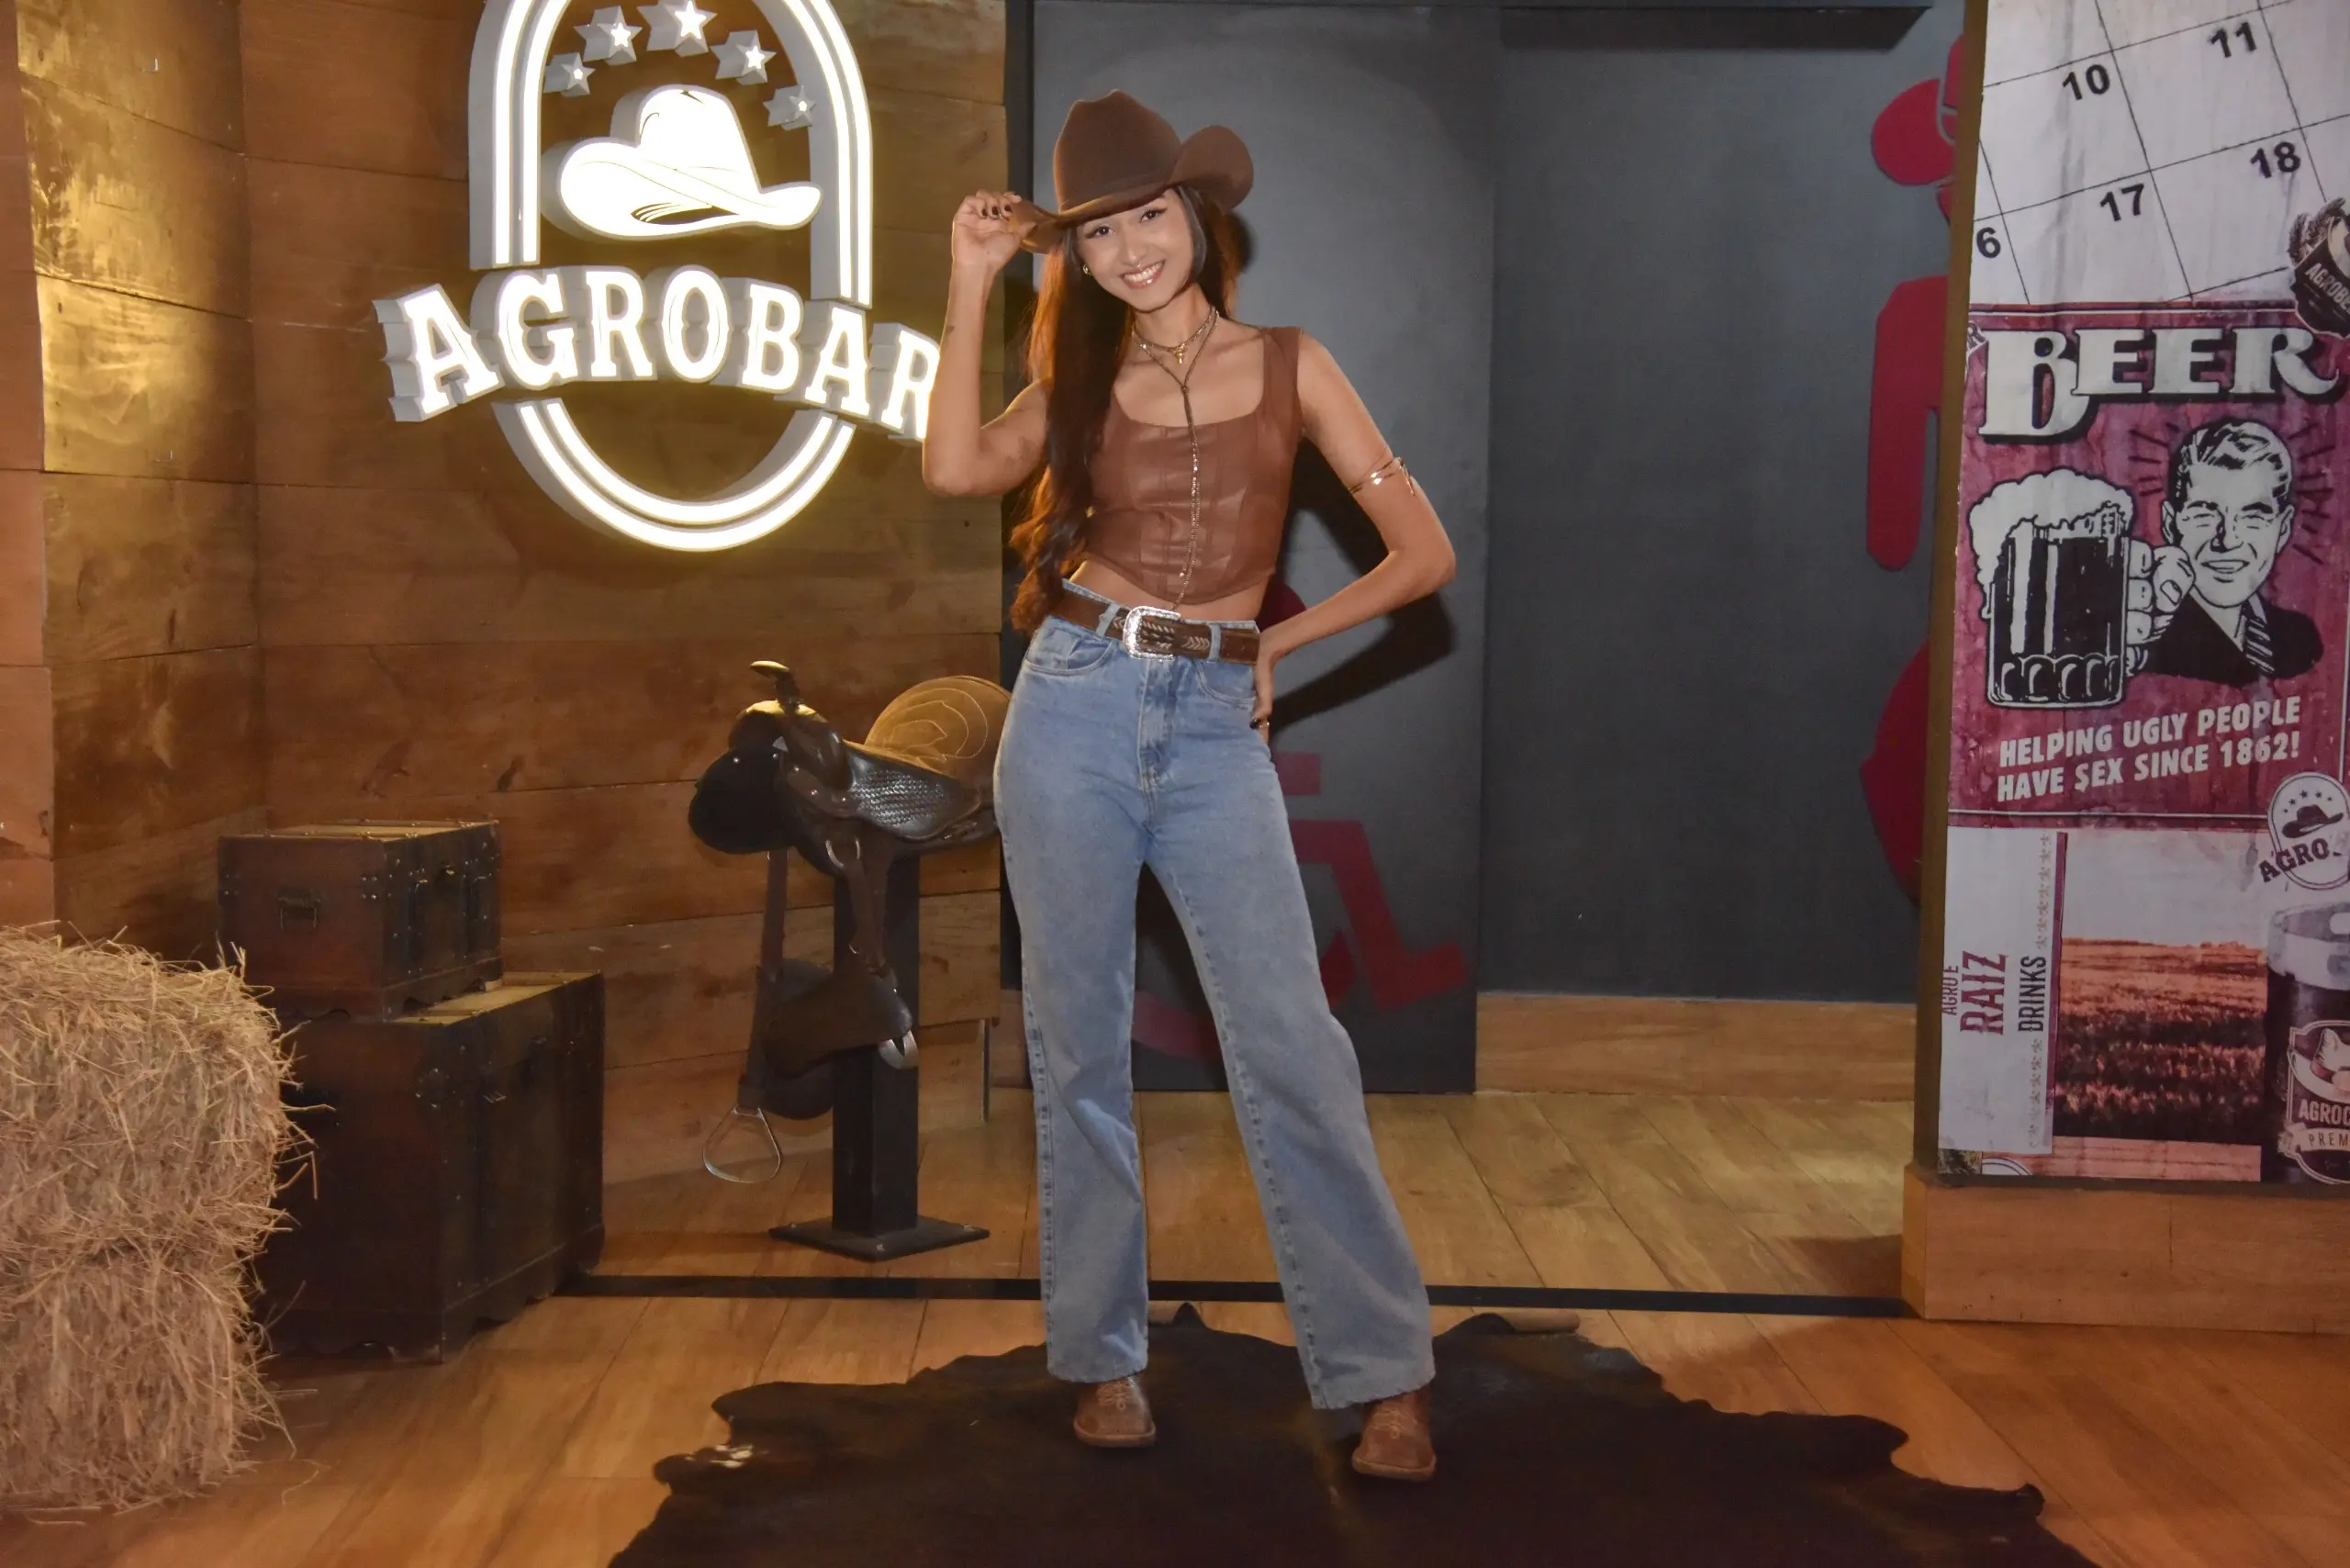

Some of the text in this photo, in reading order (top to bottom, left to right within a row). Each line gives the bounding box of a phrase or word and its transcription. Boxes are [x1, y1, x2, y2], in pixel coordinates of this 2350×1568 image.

[2063, 22, 2257, 100] 10 11
[2100, 141, 2300, 221] 17 18
[1976, 227, 2001, 258] 6
[2305, 263, 2350, 315] AGROBE
[395, 264, 941, 442] AGROBAR
[1978, 328, 2340, 436] BEER
[1998, 731, 2300, 802] HAVE SEX SINCE 1862!
[1999, 696, 2300, 767] HELPING UGLY PEOPLE
[2258, 837, 2341, 882] AGRO
[1960, 950, 2009, 1036] RAIZ
[2018, 955, 2047, 1032] DRINKS
